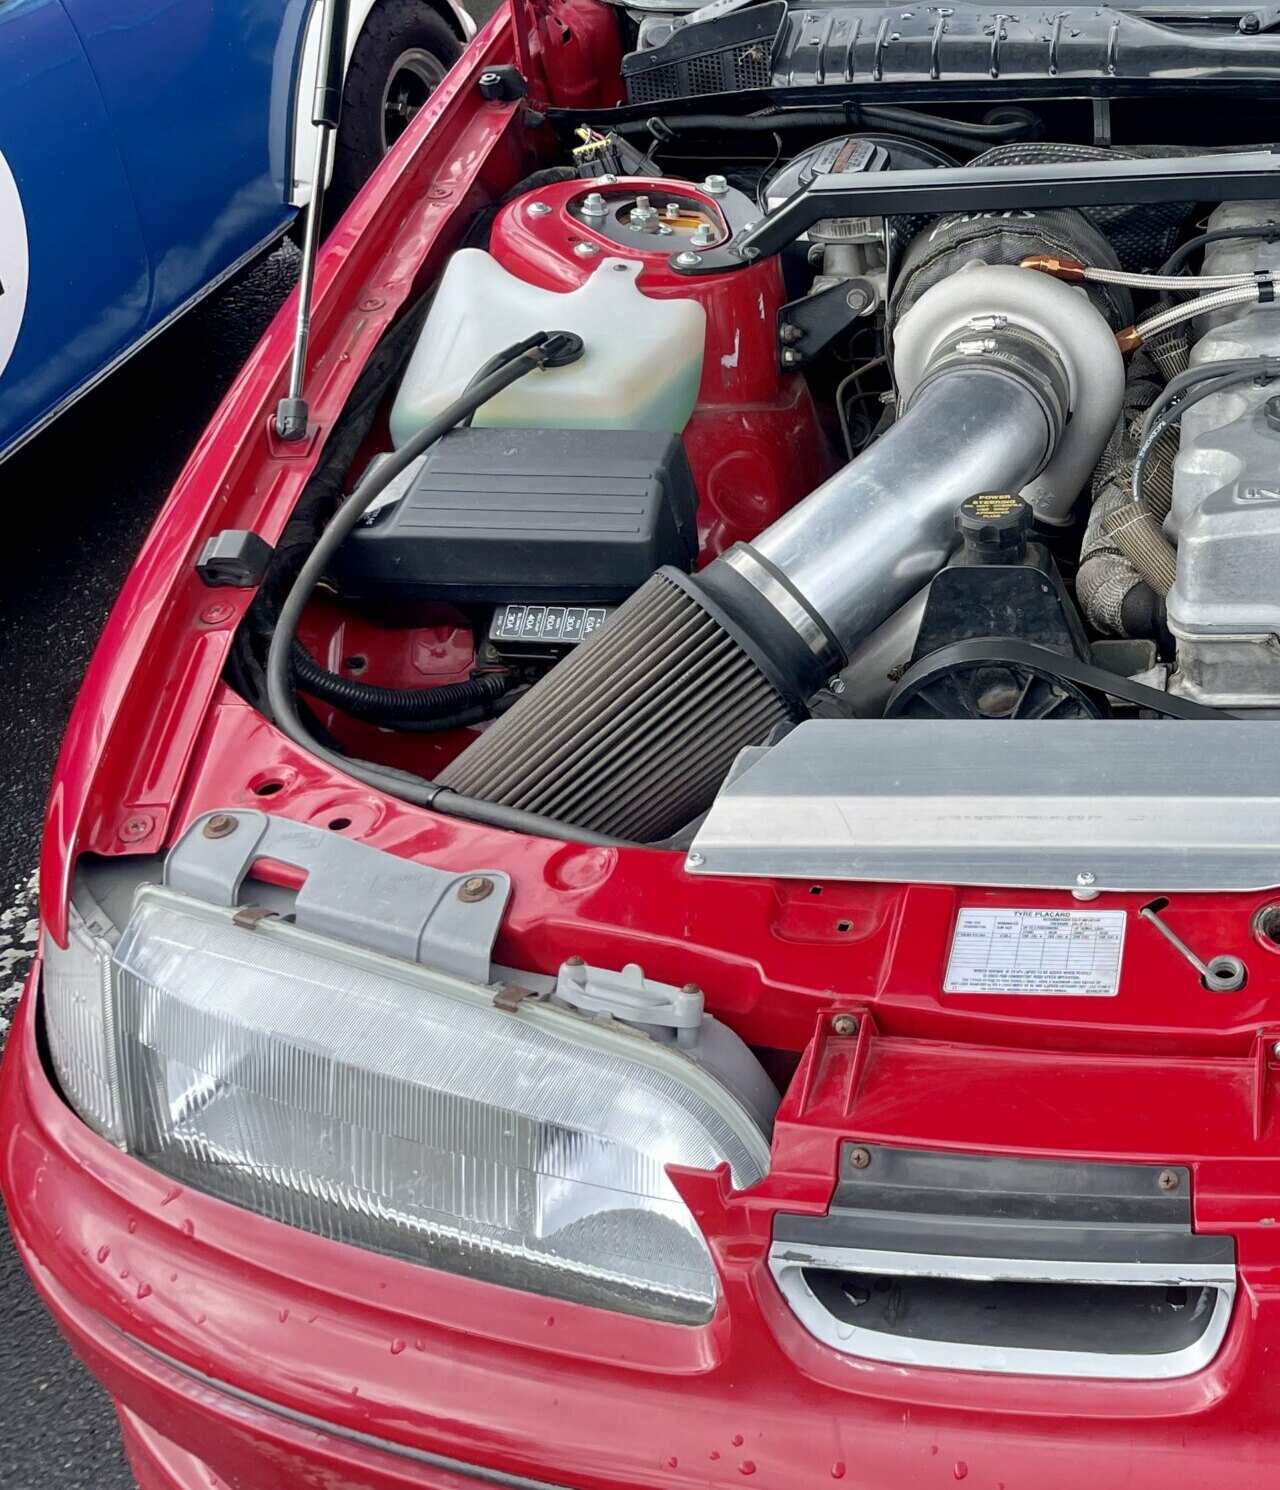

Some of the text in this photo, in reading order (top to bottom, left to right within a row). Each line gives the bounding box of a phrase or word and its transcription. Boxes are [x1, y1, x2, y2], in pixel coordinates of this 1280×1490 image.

[505, 613, 516, 630] 30A
[525, 614, 536, 630] 40A
[545, 615, 556, 631] 60A
[565, 616, 576, 632] 30A
[584, 616, 596, 633] 60A
